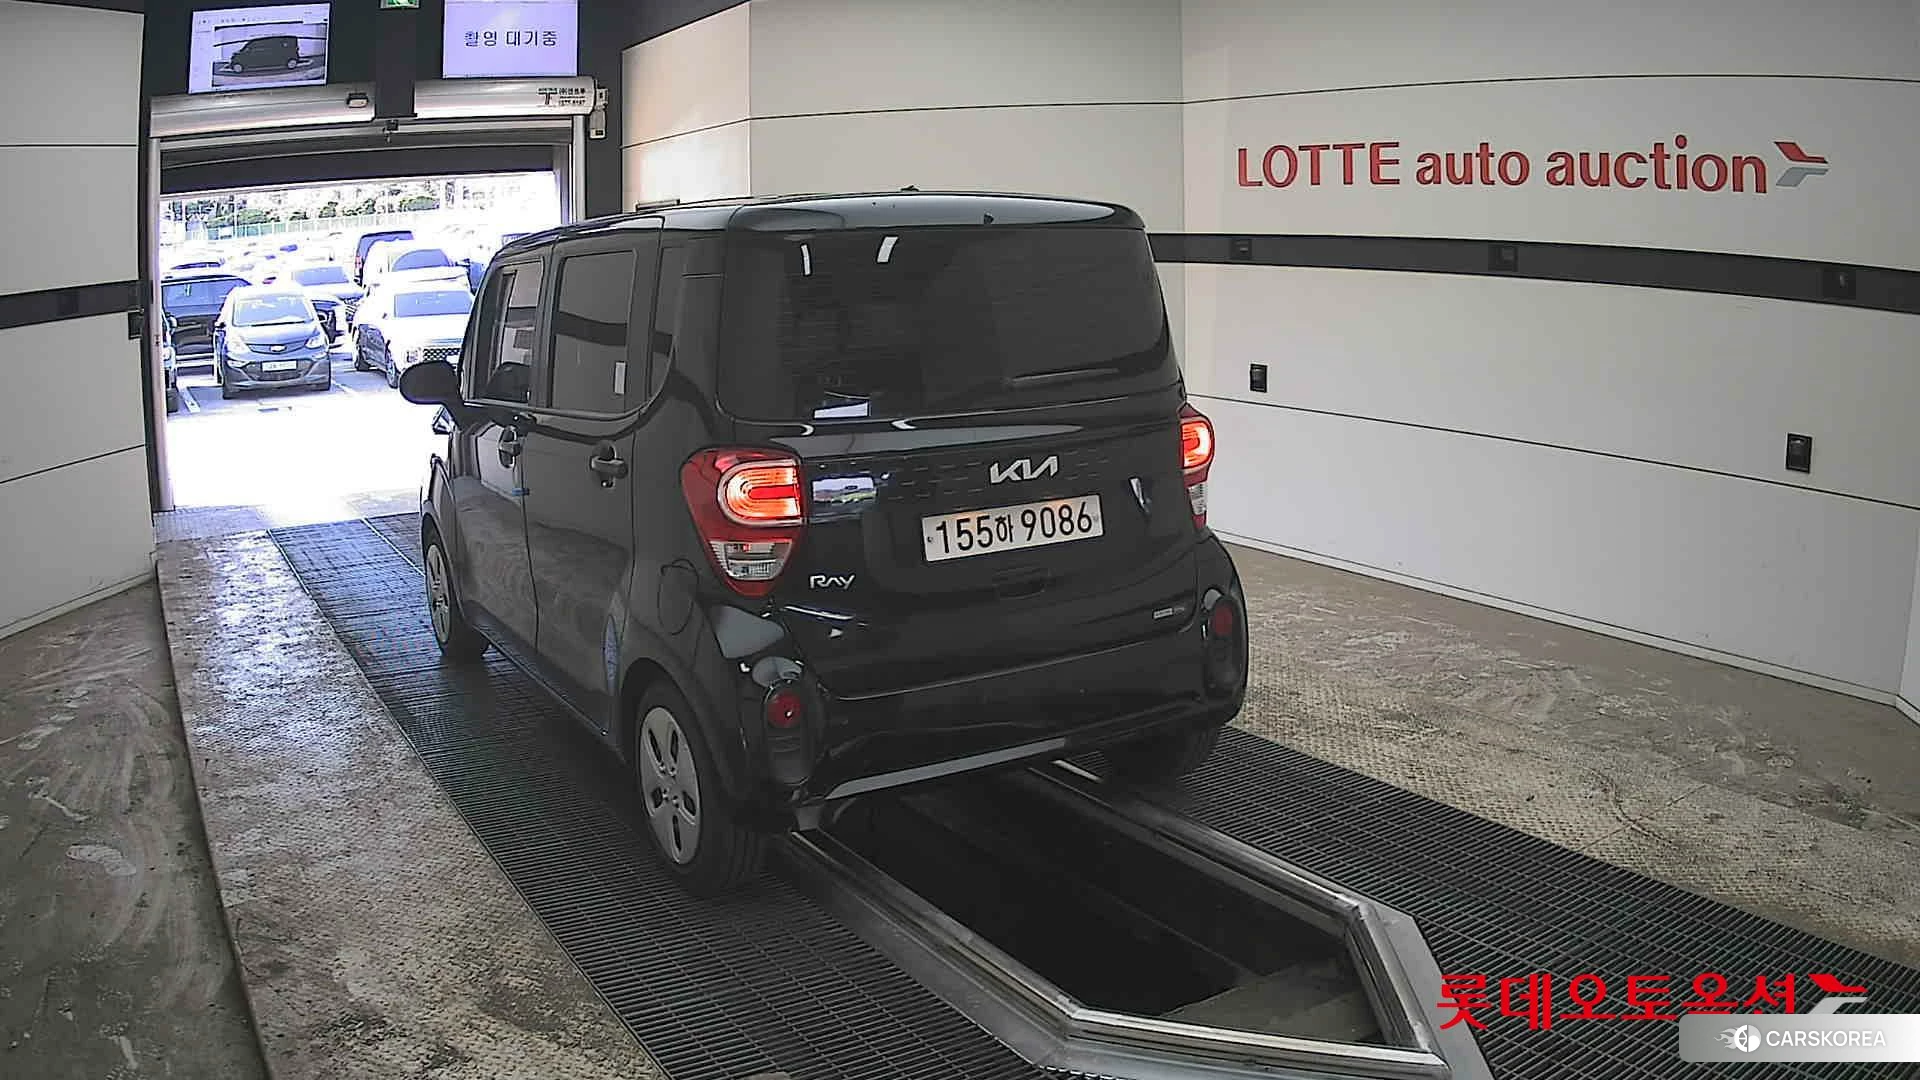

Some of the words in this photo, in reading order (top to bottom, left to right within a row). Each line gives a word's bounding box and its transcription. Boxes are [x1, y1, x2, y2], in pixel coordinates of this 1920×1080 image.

[506, 30, 557, 47] 대기중
[1236, 141, 1401, 188] LOTTE
[1415, 142, 1531, 187] auto
[1545, 134, 1767, 194] auction
[989, 455, 1059, 484] KIA
[809, 573, 856, 590] RAY
